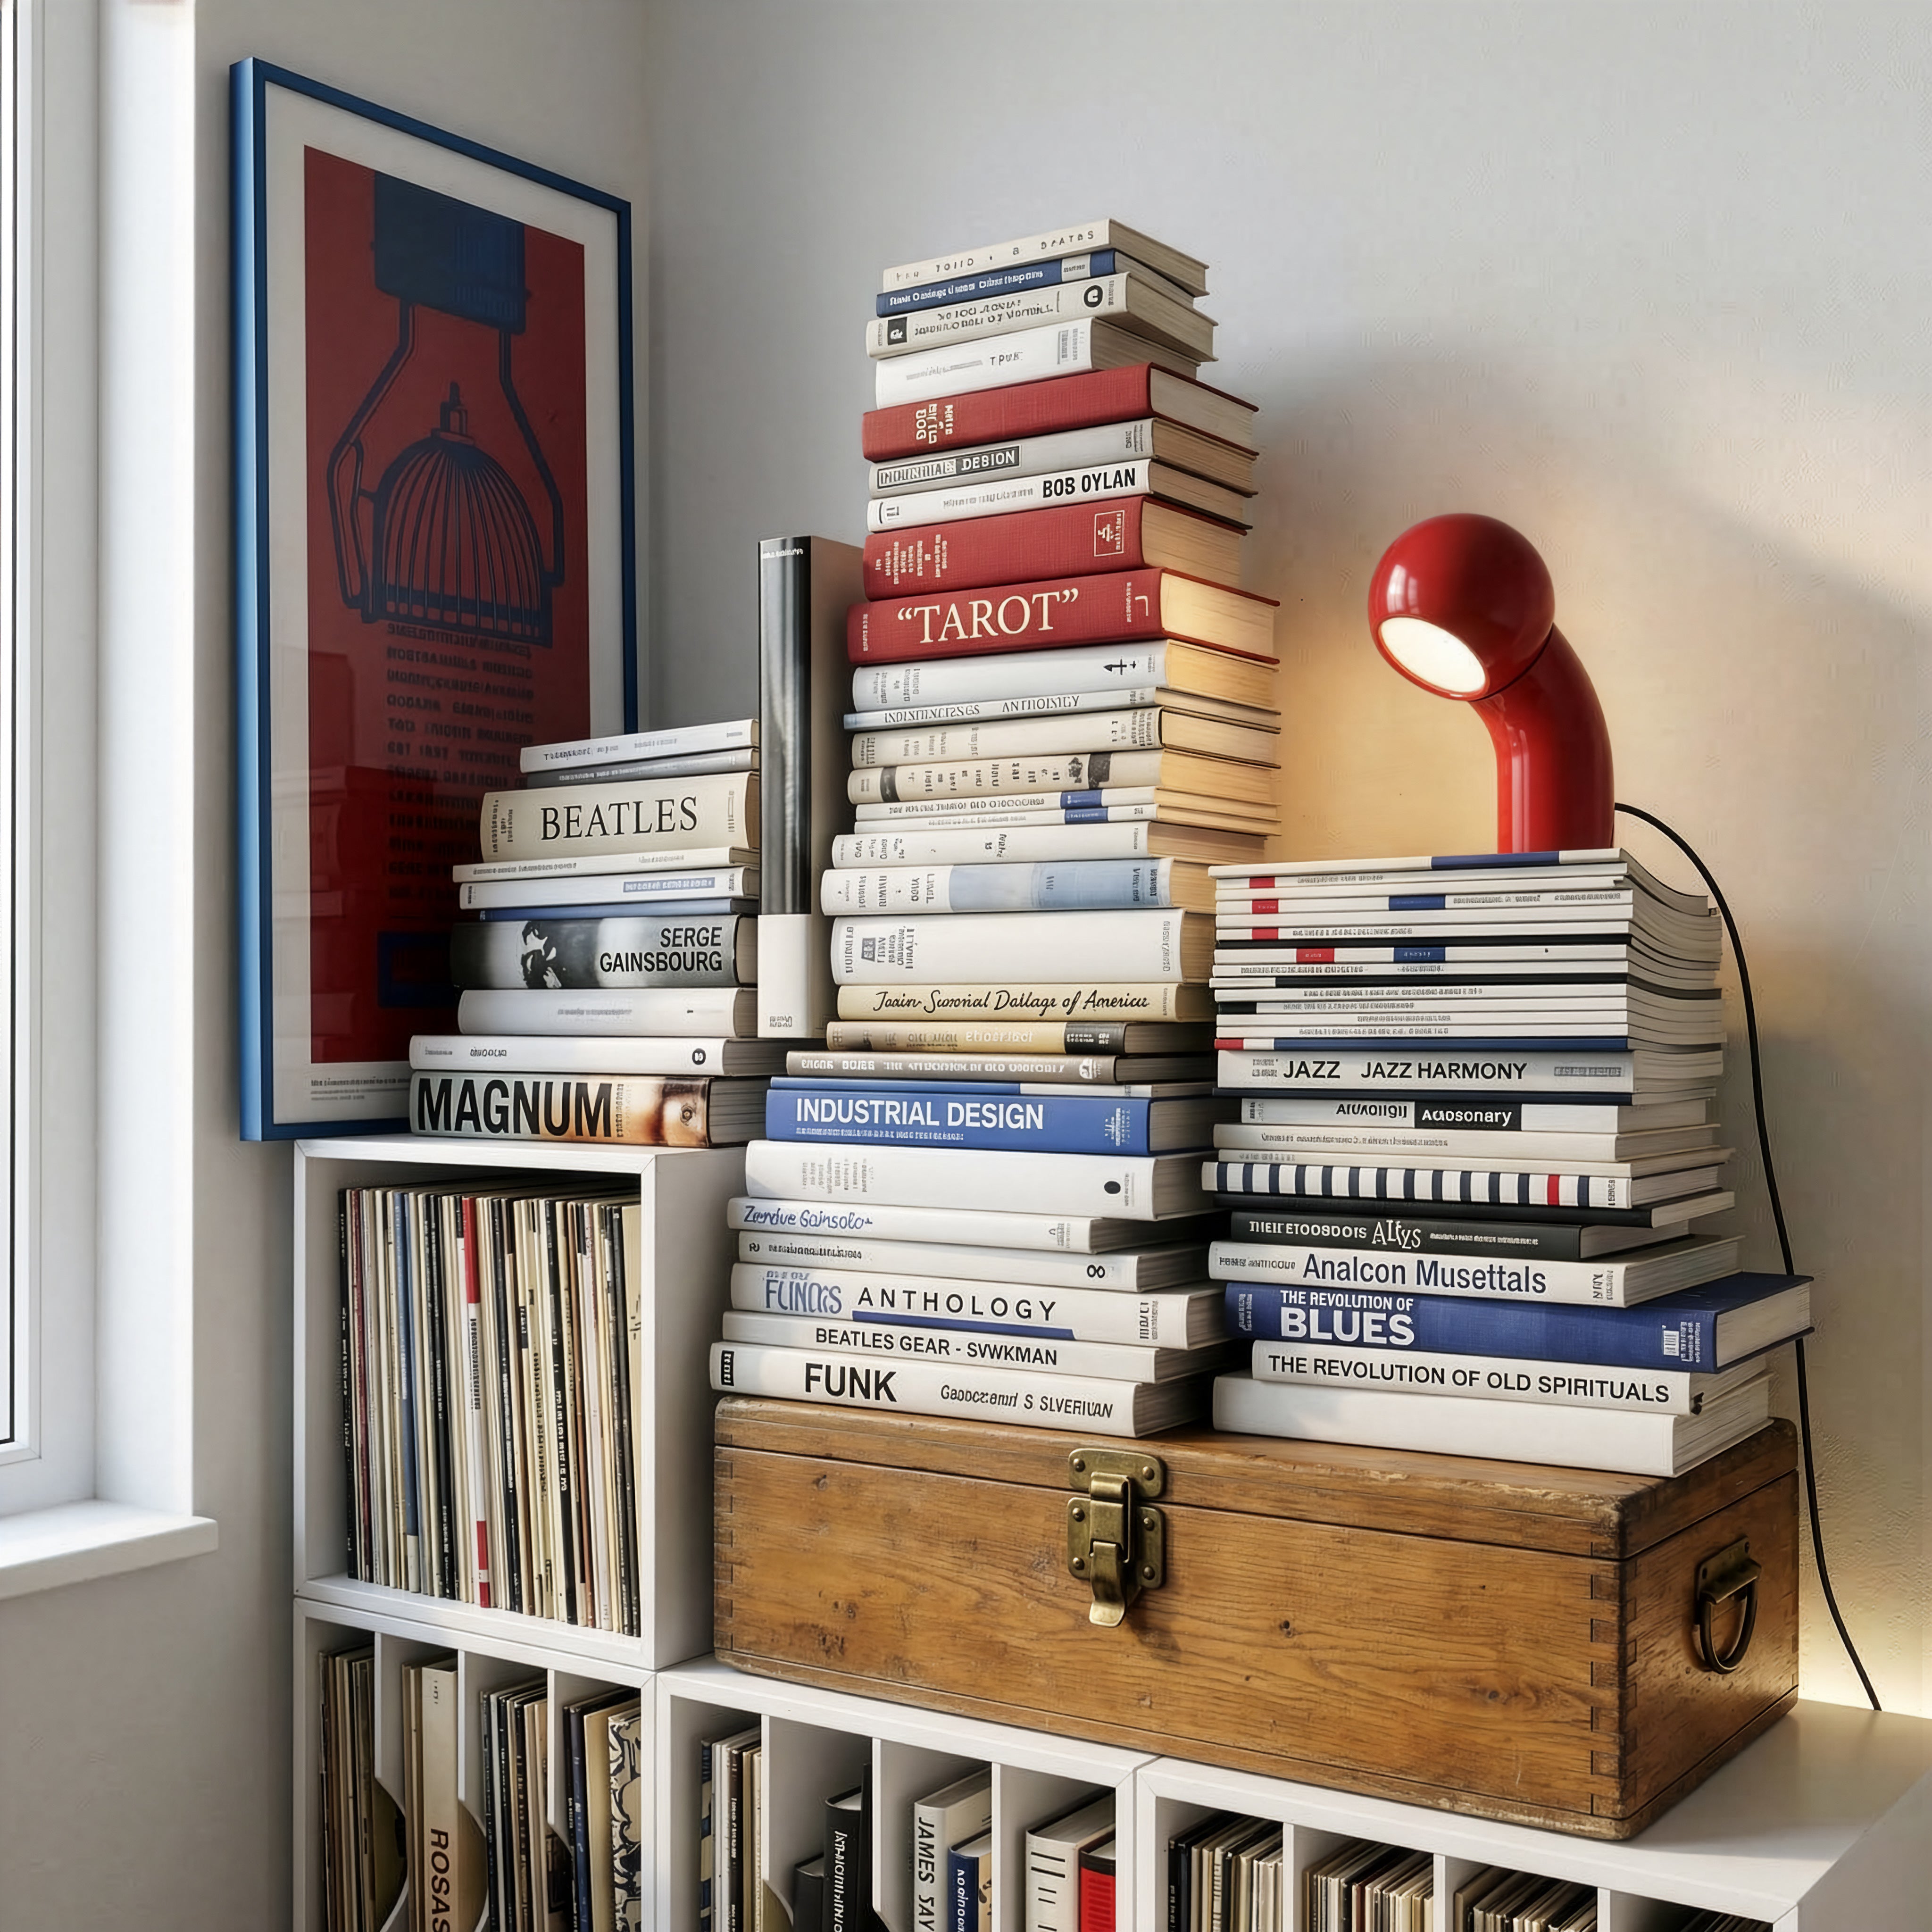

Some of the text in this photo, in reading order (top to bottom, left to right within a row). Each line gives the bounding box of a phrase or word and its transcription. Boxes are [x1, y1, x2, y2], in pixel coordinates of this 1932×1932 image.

[541, 797, 697, 840] BEATLES
[660, 927, 722, 948] SERGE
[600, 951, 722, 972] GAINSBOURG
[1062, 991, 1081, 1015] of
[1283, 1061, 1527, 1079] JAZZ JAZZ HARMONY
[417, 1078, 612, 1138] MAGNUM
[797, 1099, 1043, 1129] INDUSTRIAL DESIGN
[1303, 1254, 1405, 1284] Analcon
[1417, 1260, 1546, 1293] Musettals
[858, 1287, 1056, 1321] ANTHOLOGY
[1280, 1290, 1413, 1311] THE REVOLUTION OF
[816, 1328, 894, 1349] BEATLES
[900, 1336, 949, 1355] GEAR
[1281, 1307, 1414, 1345] BLUES
[806, 1363, 897, 1402] FUNK
[1268, 1355, 1669, 1402] THE REVOLUTION OF OLD SPIRITUALS
[918, 1817, 934, 1883] JAMES
